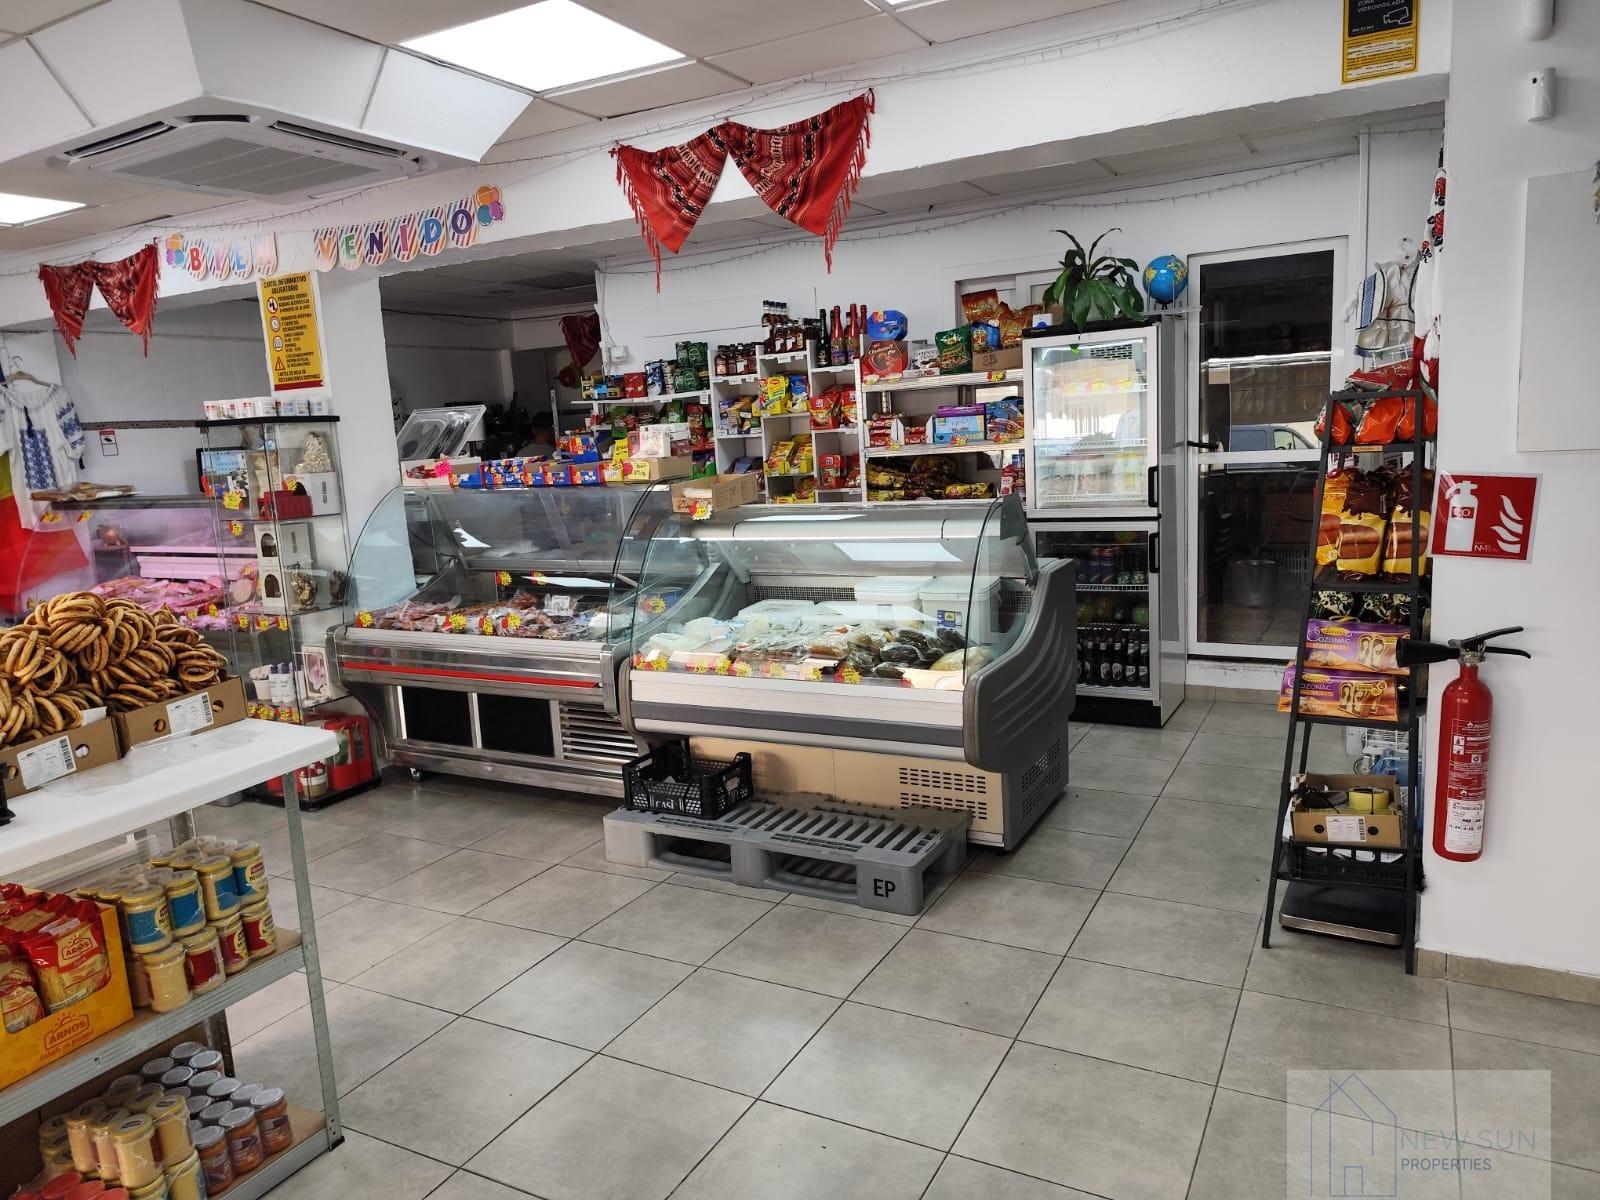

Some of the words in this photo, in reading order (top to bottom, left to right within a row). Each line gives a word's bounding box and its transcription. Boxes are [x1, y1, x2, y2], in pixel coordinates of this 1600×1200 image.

[318, 208, 473, 261] VENIDO
[278, 275, 307, 286] INFORMATIVO
[873, 878, 897, 898] EP
[49, 1019, 86, 1045] ARNOS
